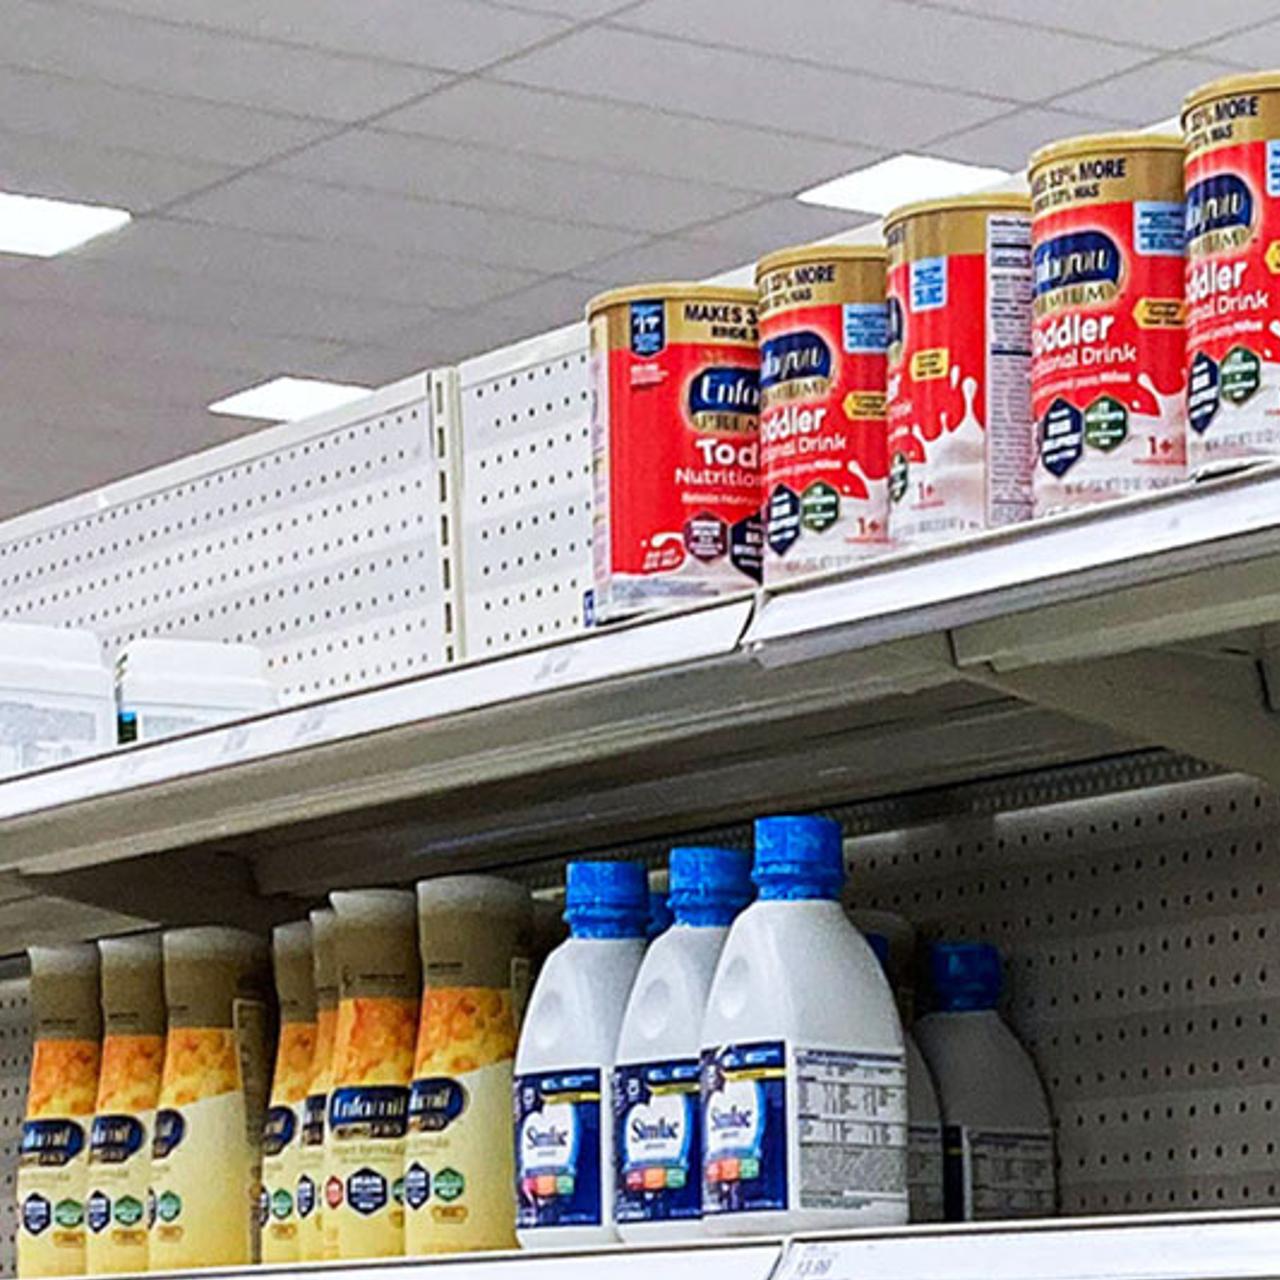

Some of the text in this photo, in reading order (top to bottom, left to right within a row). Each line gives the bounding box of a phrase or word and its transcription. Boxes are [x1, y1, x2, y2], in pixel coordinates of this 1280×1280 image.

[1079, 158, 1127, 179] MORE
[795, 265, 836, 284] MORE
[1217, 290, 1269, 314] Drink
[684, 305, 742, 325] MAKES
[1082, 343, 1137, 365] Drink
[800, 433, 847, 452] Drink
[1149, 436, 1173, 455] 1+
[858, 517, 881, 534] 1+
